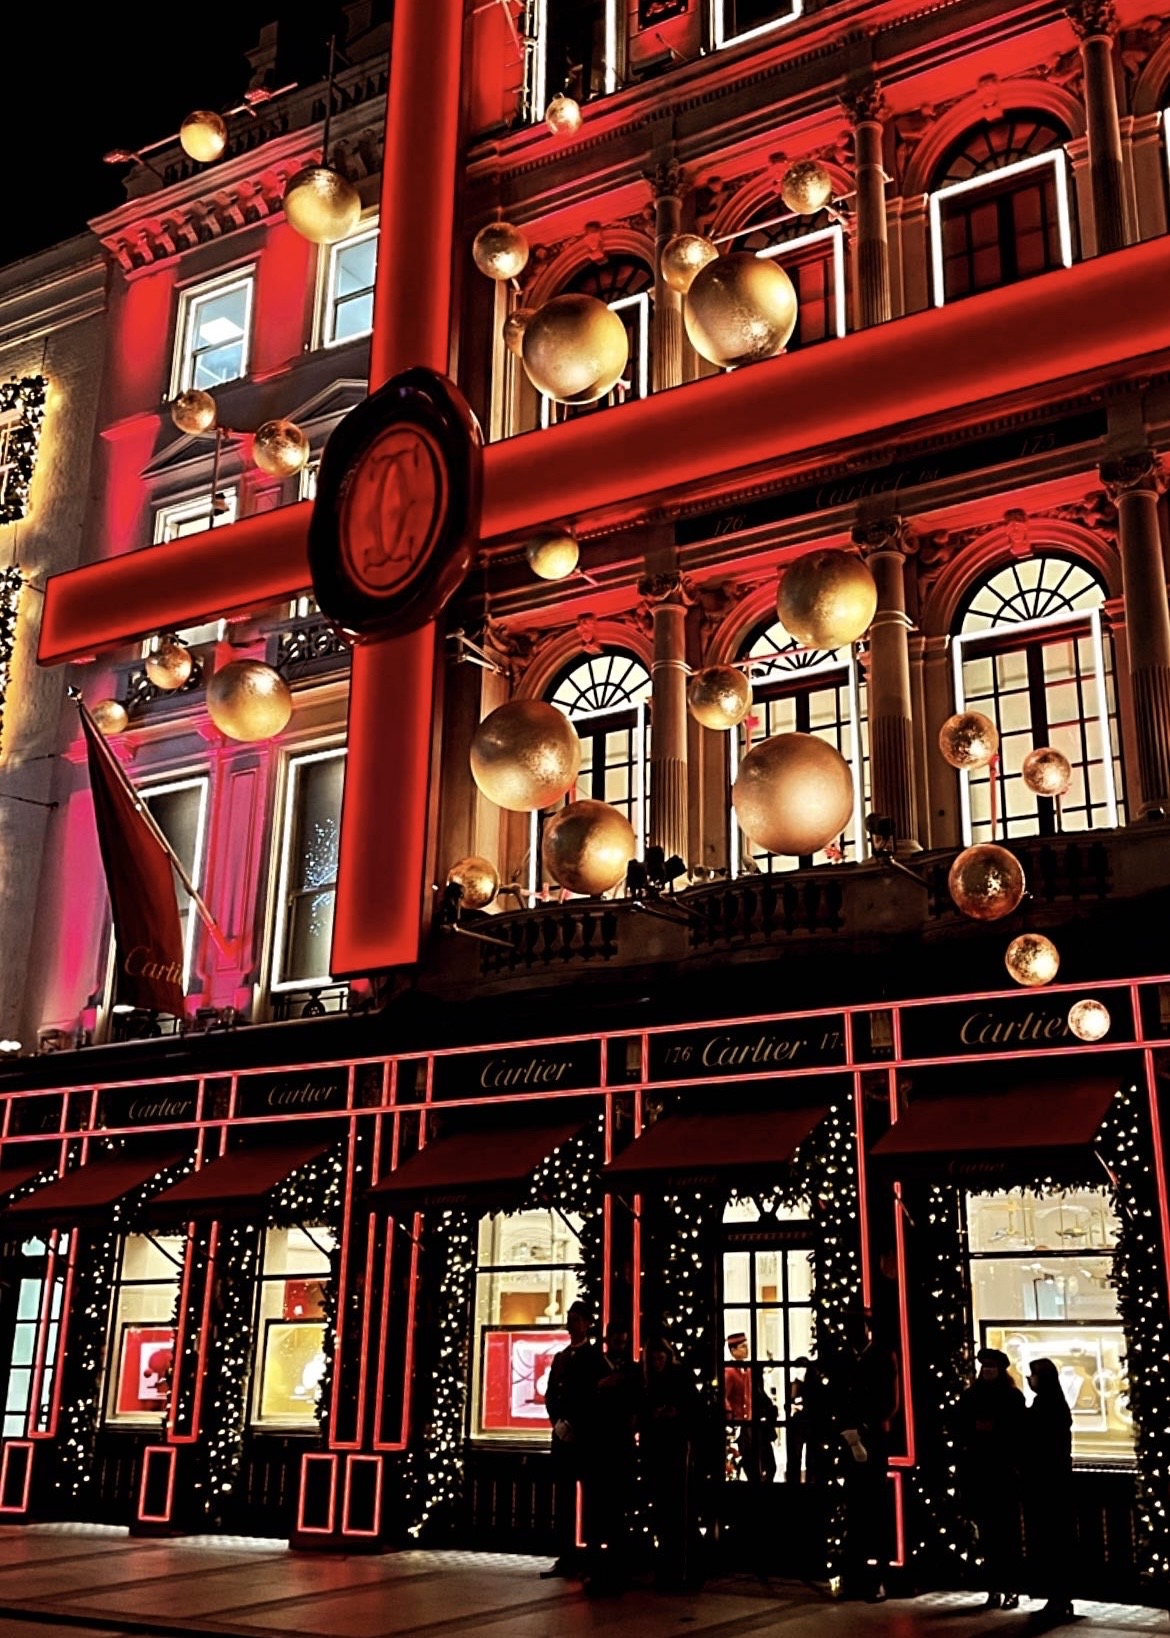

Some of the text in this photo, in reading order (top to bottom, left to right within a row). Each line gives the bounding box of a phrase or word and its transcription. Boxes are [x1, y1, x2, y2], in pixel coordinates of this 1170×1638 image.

[664, 1031, 844, 1067] 176 Cartier 17
[479, 1057, 573, 1088] Cartier
[267, 1082, 339, 1106] Cartier
[127, 1096, 192, 1120] Cartier
